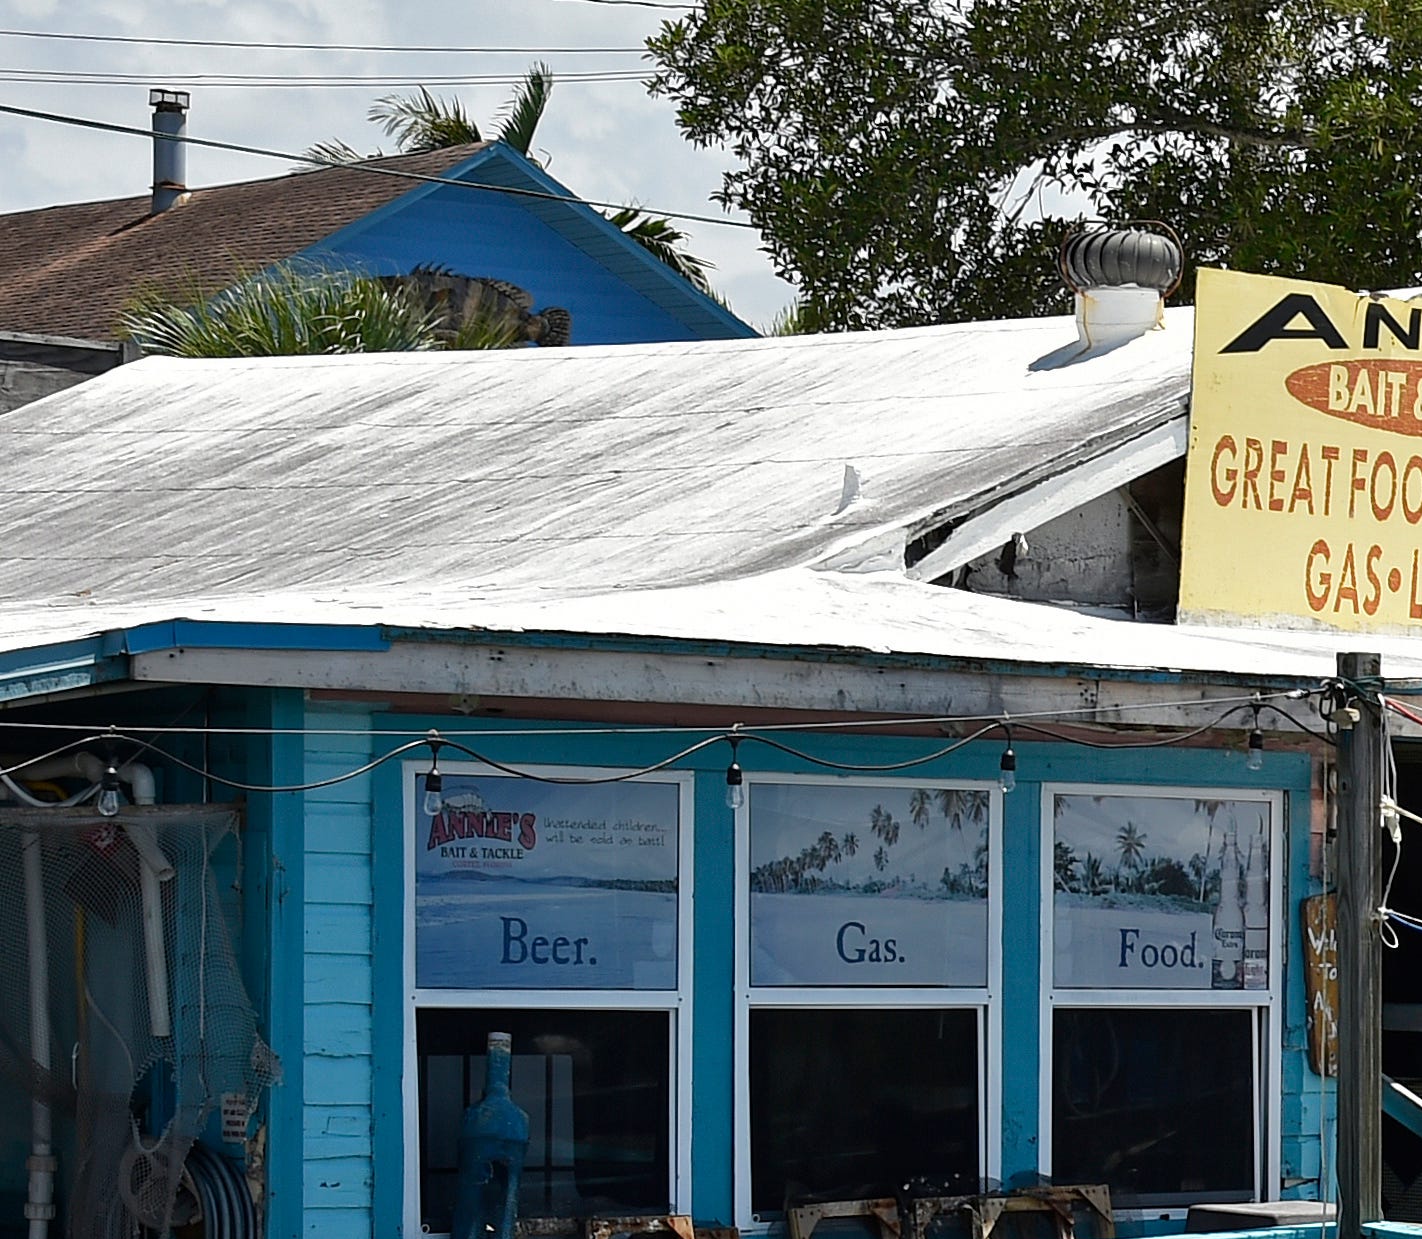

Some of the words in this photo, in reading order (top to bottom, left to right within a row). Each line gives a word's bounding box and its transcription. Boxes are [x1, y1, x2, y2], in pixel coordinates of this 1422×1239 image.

[1328, 364, 1407, 418] BAIT
[1211, 434, 1340, 516] GREAT
[1305, 538, 1383, 616] GAS
[428, 811, 536, 850] ANNIE'S
[441, 846, 467, 859] BAIT
[469, 848, 478, 859] &
[481, 848, 524, 859] TACKLE
[499, 916, 598, 966] Beer.
[836, 921, 906, 964] Gas.
[1118, 928, 1205, 969] Food.
